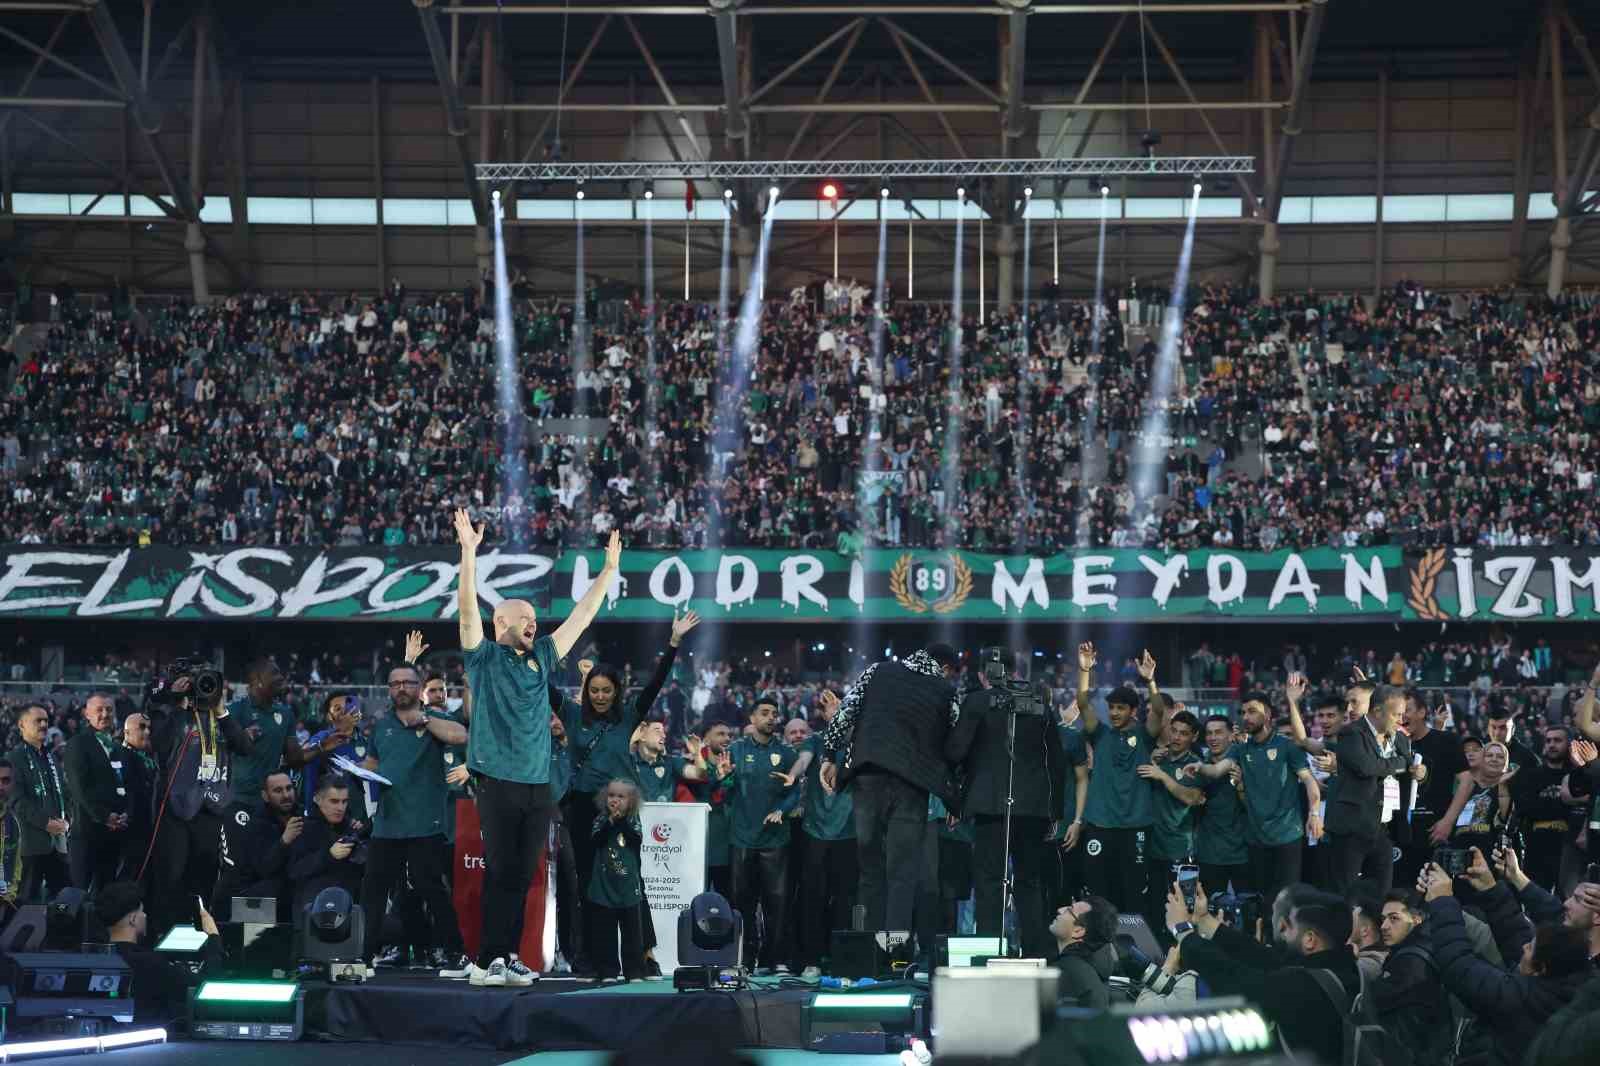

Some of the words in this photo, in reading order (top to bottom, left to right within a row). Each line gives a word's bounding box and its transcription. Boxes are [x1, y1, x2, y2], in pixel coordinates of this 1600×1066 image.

[916, 567, 946, 591] 89
[992, 553, 1388, 611] MEYDAN
[642, 844, 682, 854] trendyol
